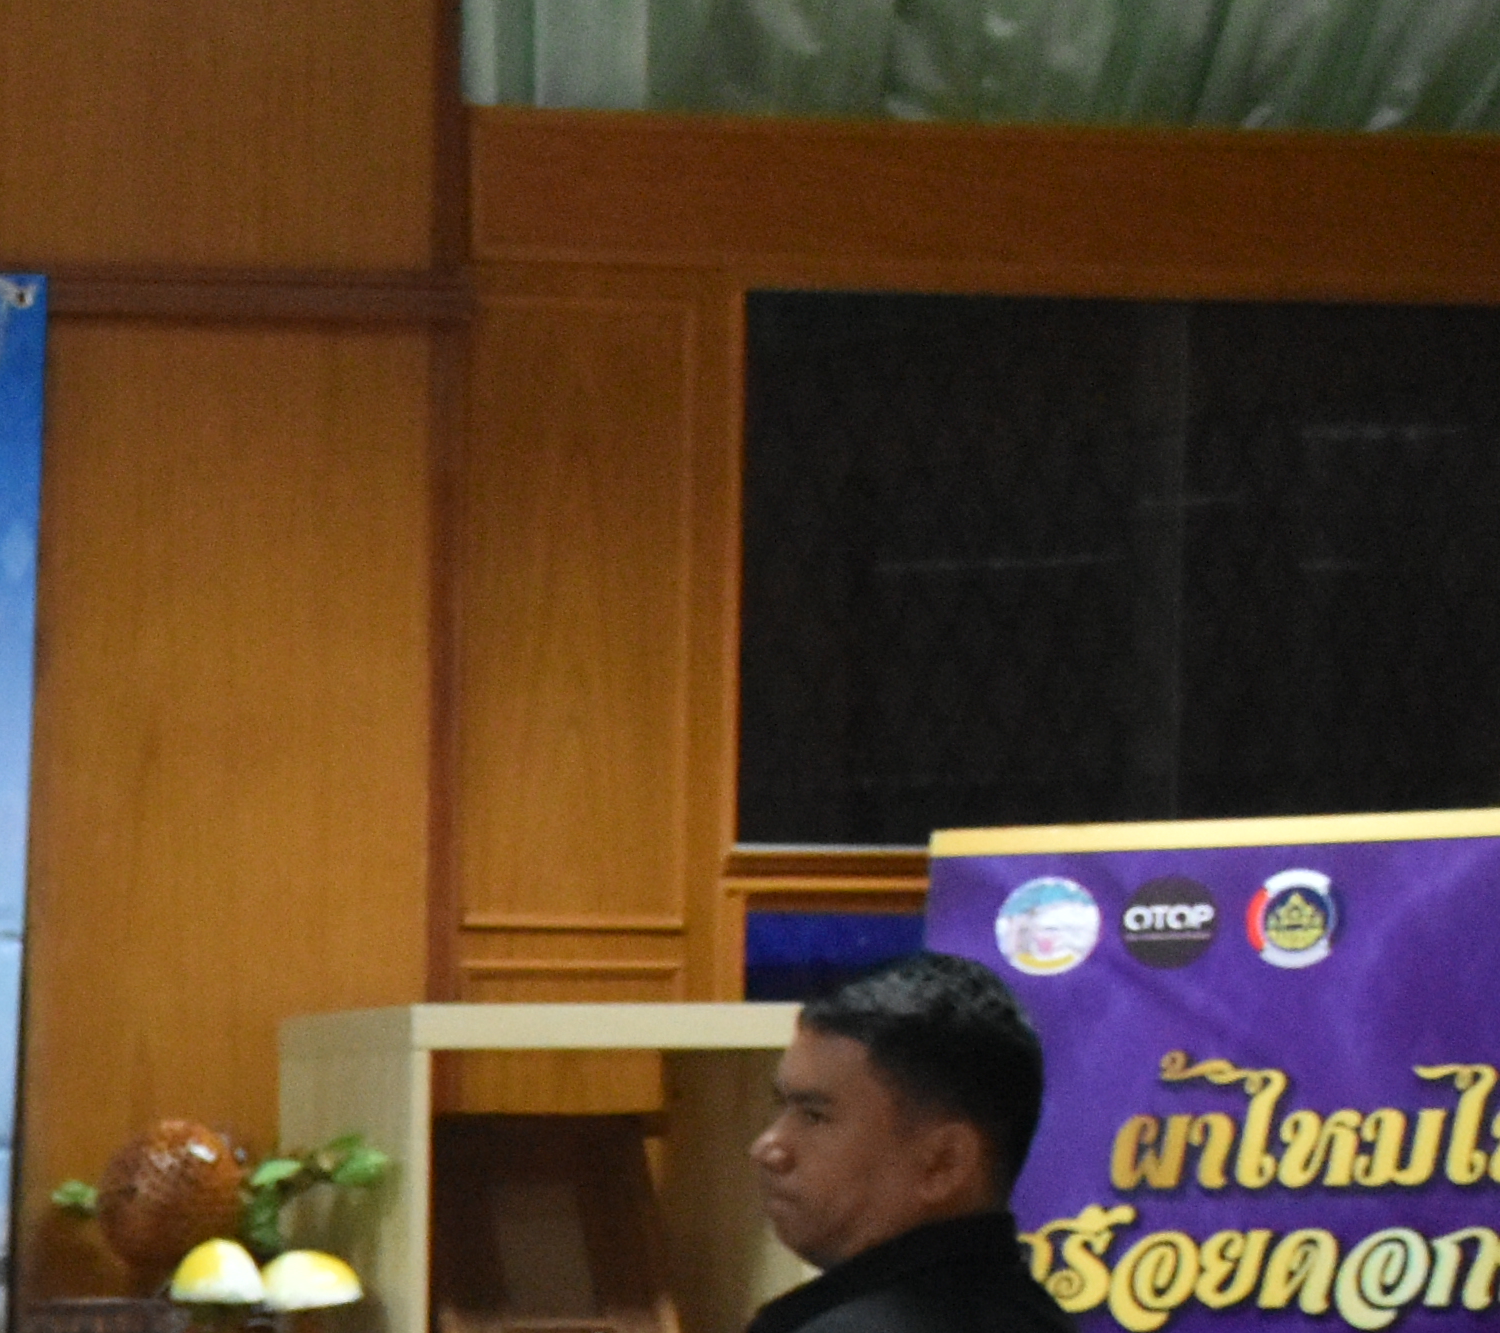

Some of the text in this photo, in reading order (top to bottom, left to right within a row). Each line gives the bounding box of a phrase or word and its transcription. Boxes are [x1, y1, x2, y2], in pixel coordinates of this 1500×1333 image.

[1123, 903, 1215, 931] OTOP
[1110, 1049, 1500, 1190] ผ้าไหมไ
